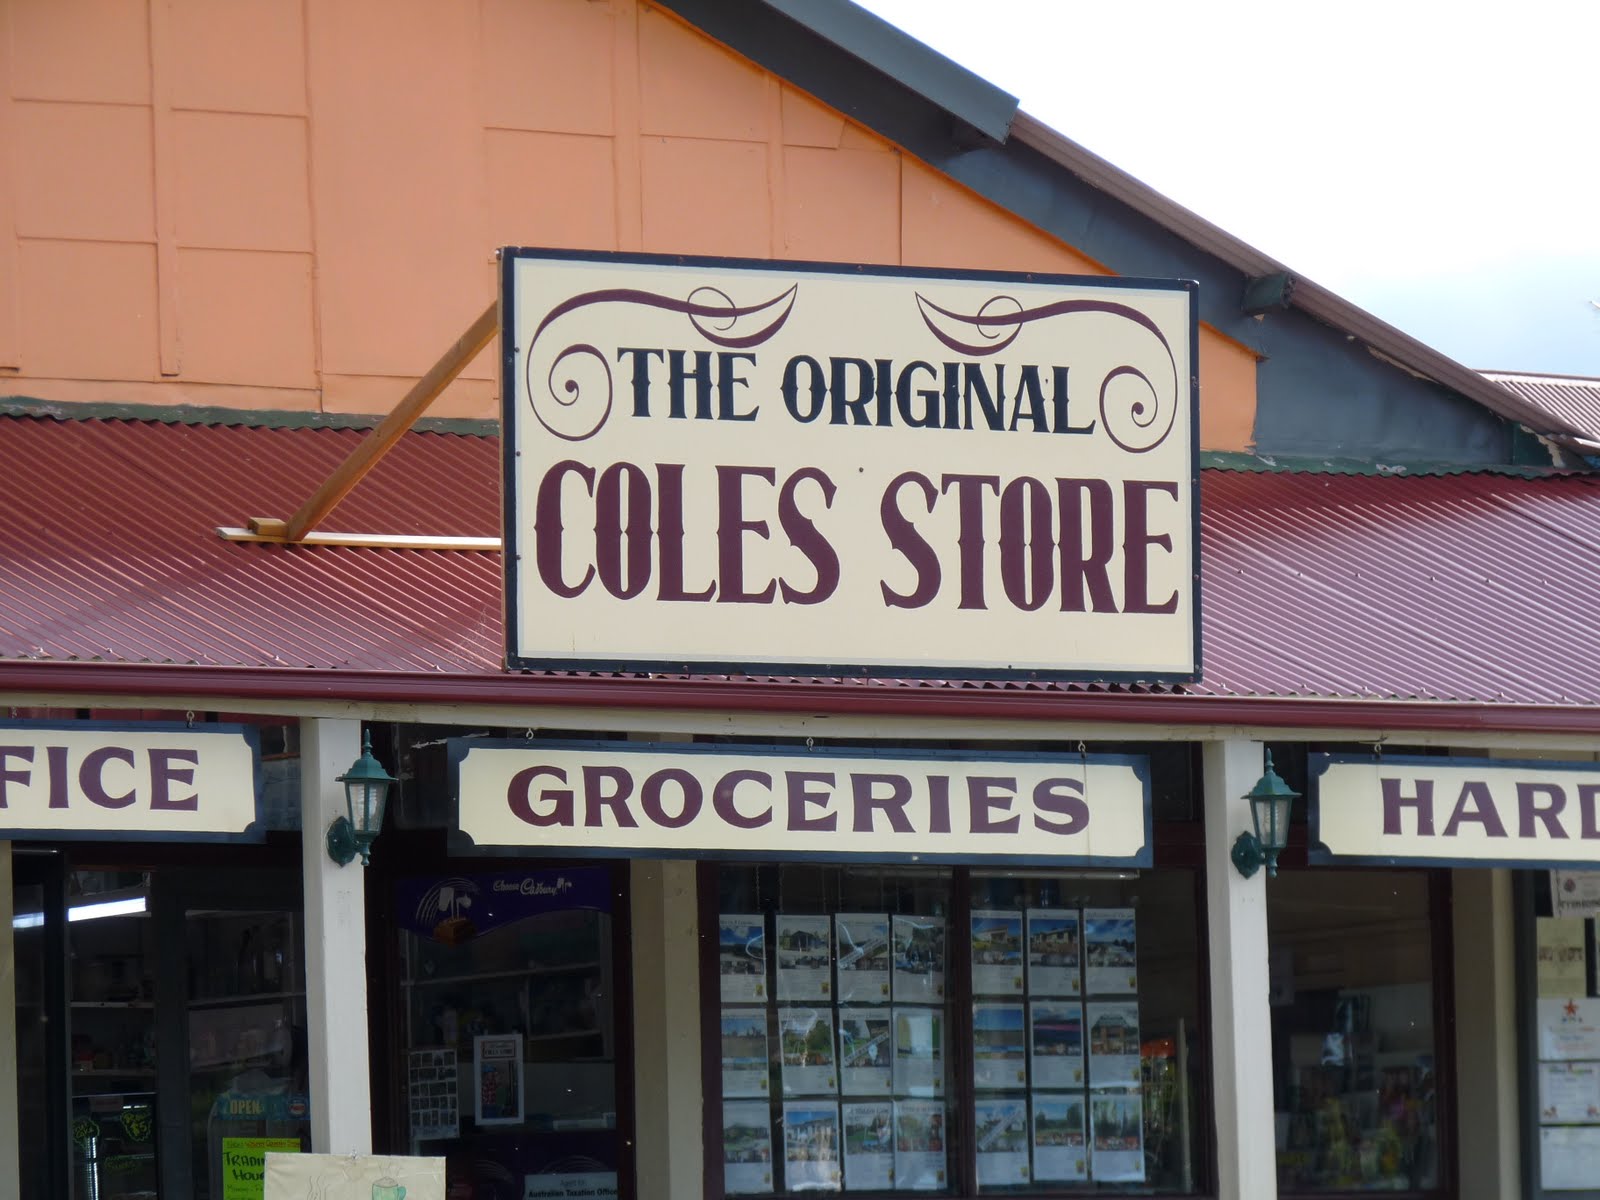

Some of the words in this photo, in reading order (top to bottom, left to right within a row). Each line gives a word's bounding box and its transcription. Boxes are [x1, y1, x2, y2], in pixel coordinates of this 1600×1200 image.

[618, 349, 759, 421] THE
[780, 355, 1095, 434] ORIGINAL
[534, 460, 839, 604] COLES
[880, 472, 1178, 614] STORE
[507, 765, 1090, 836] GROCERIES
[230, 1100, 261, 1114] OPEN
[529, 1189, 564, 1198] Australian
[566, 1188, 595, 1197] Taxation
